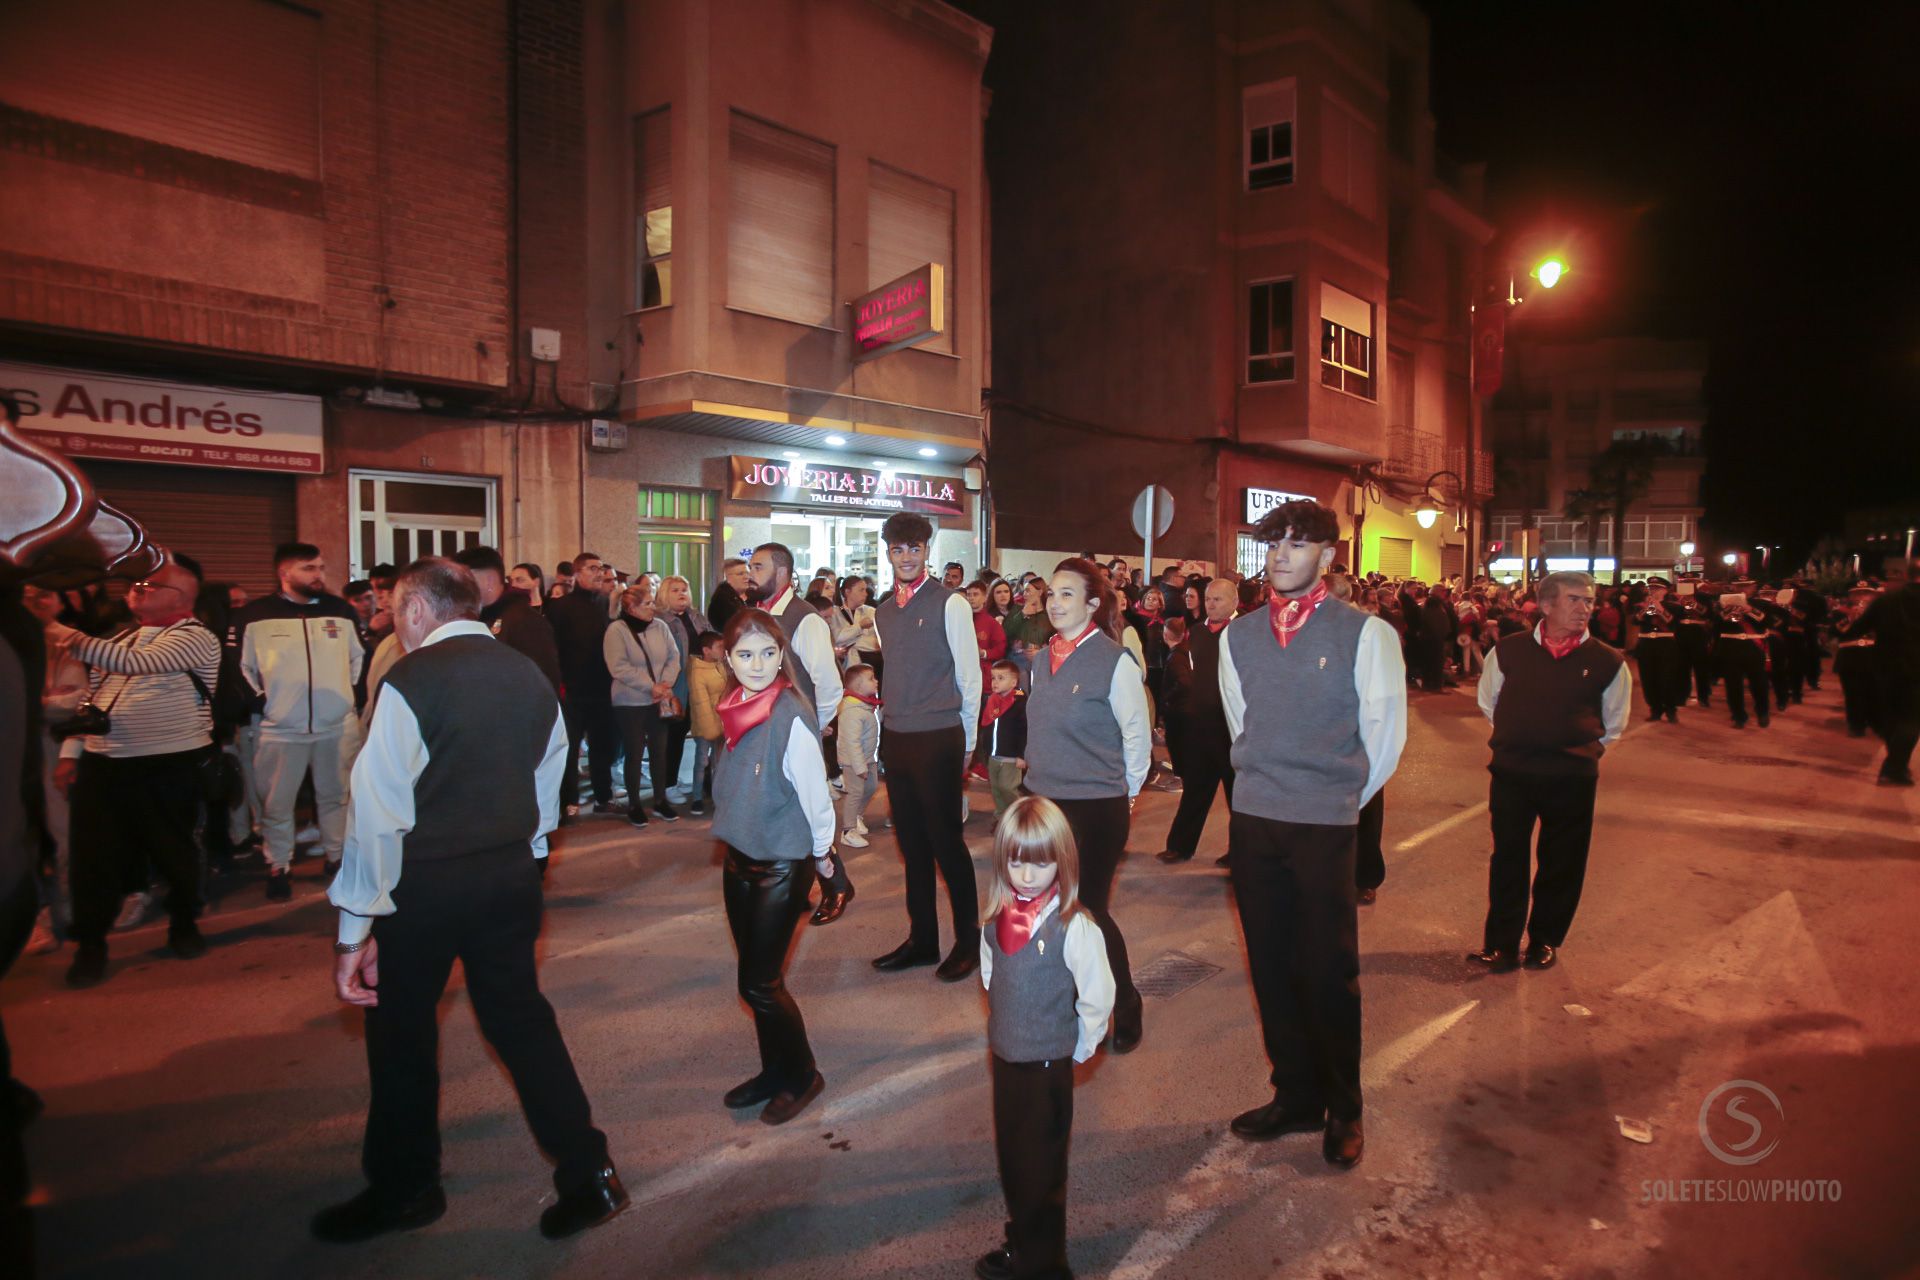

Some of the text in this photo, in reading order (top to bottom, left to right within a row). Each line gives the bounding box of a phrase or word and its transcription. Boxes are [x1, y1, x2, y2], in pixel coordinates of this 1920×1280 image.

[856, 278, 926, 325] JOYERIA
[51, 383, 264, 438] Andrés
[139, 444, 194, 457] DUCATI
[262, 454, 286, 465] 444
[745, 463, 956, 502] JOYERIA PADILLA
[810, 493, 848, 504] TALLER
[849, 496, 863, 505] DE
[1251, 492, 1290, 509] URS
